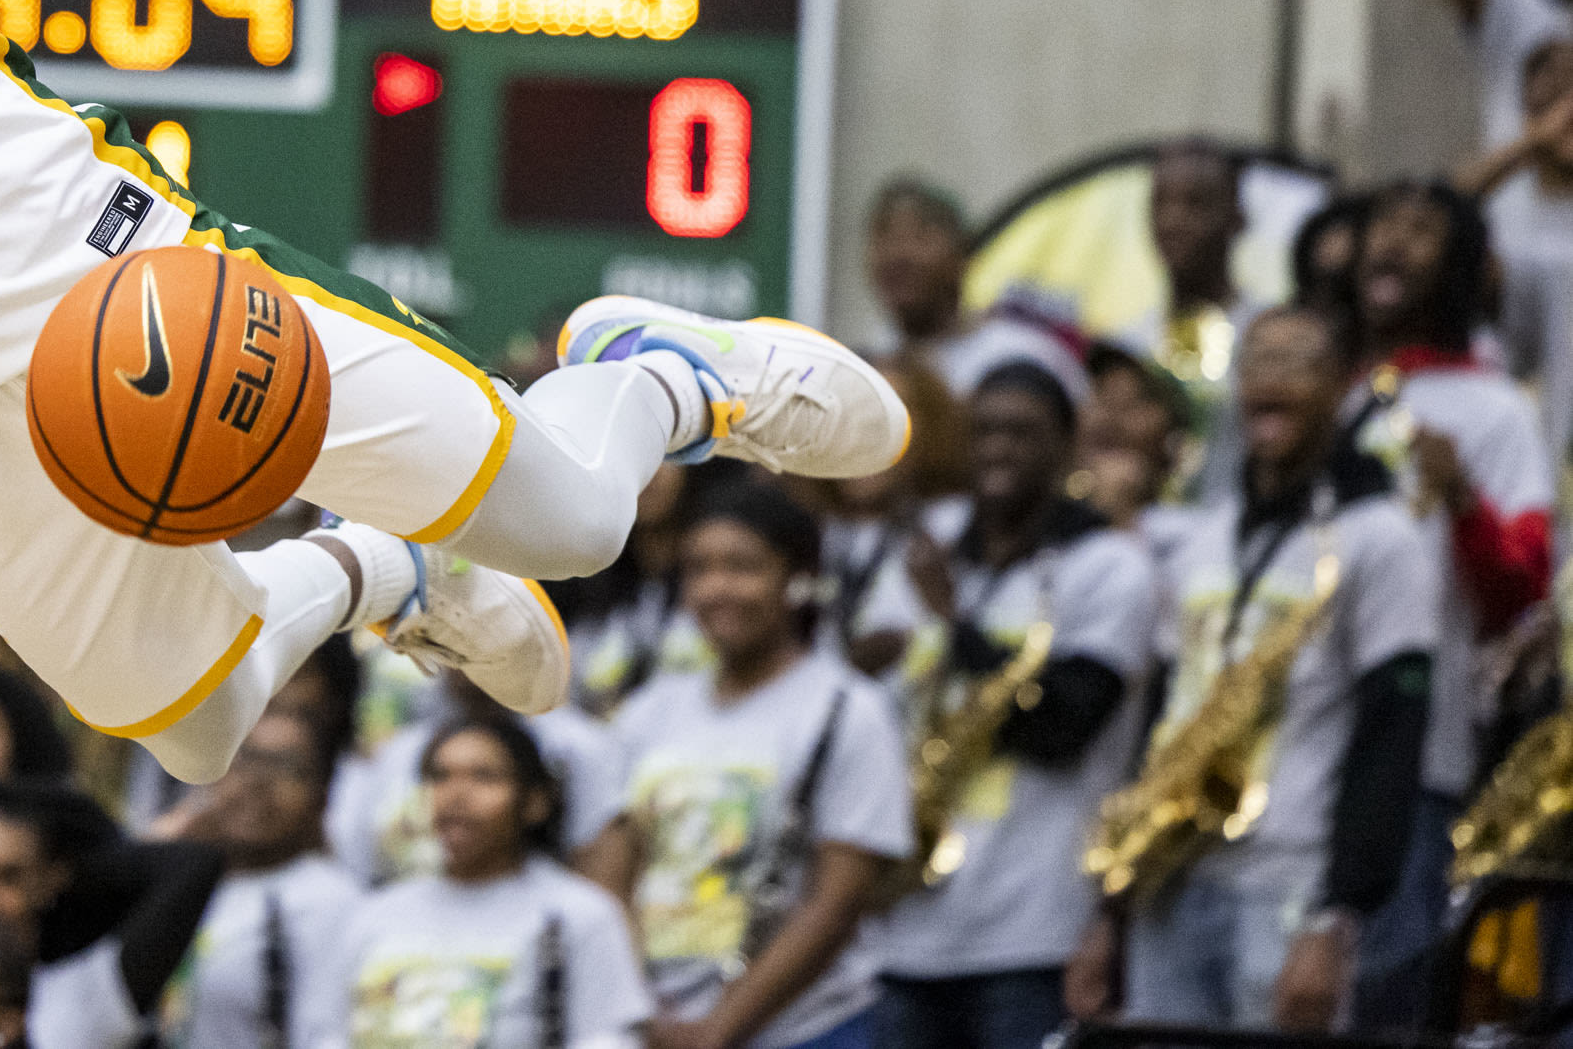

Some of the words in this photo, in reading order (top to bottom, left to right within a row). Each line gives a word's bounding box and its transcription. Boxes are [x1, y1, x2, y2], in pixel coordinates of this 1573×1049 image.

[123, 194, 141, 212] M
[645, 77, 752, 238] 0
[217, 285, 281, 434] ELITE
